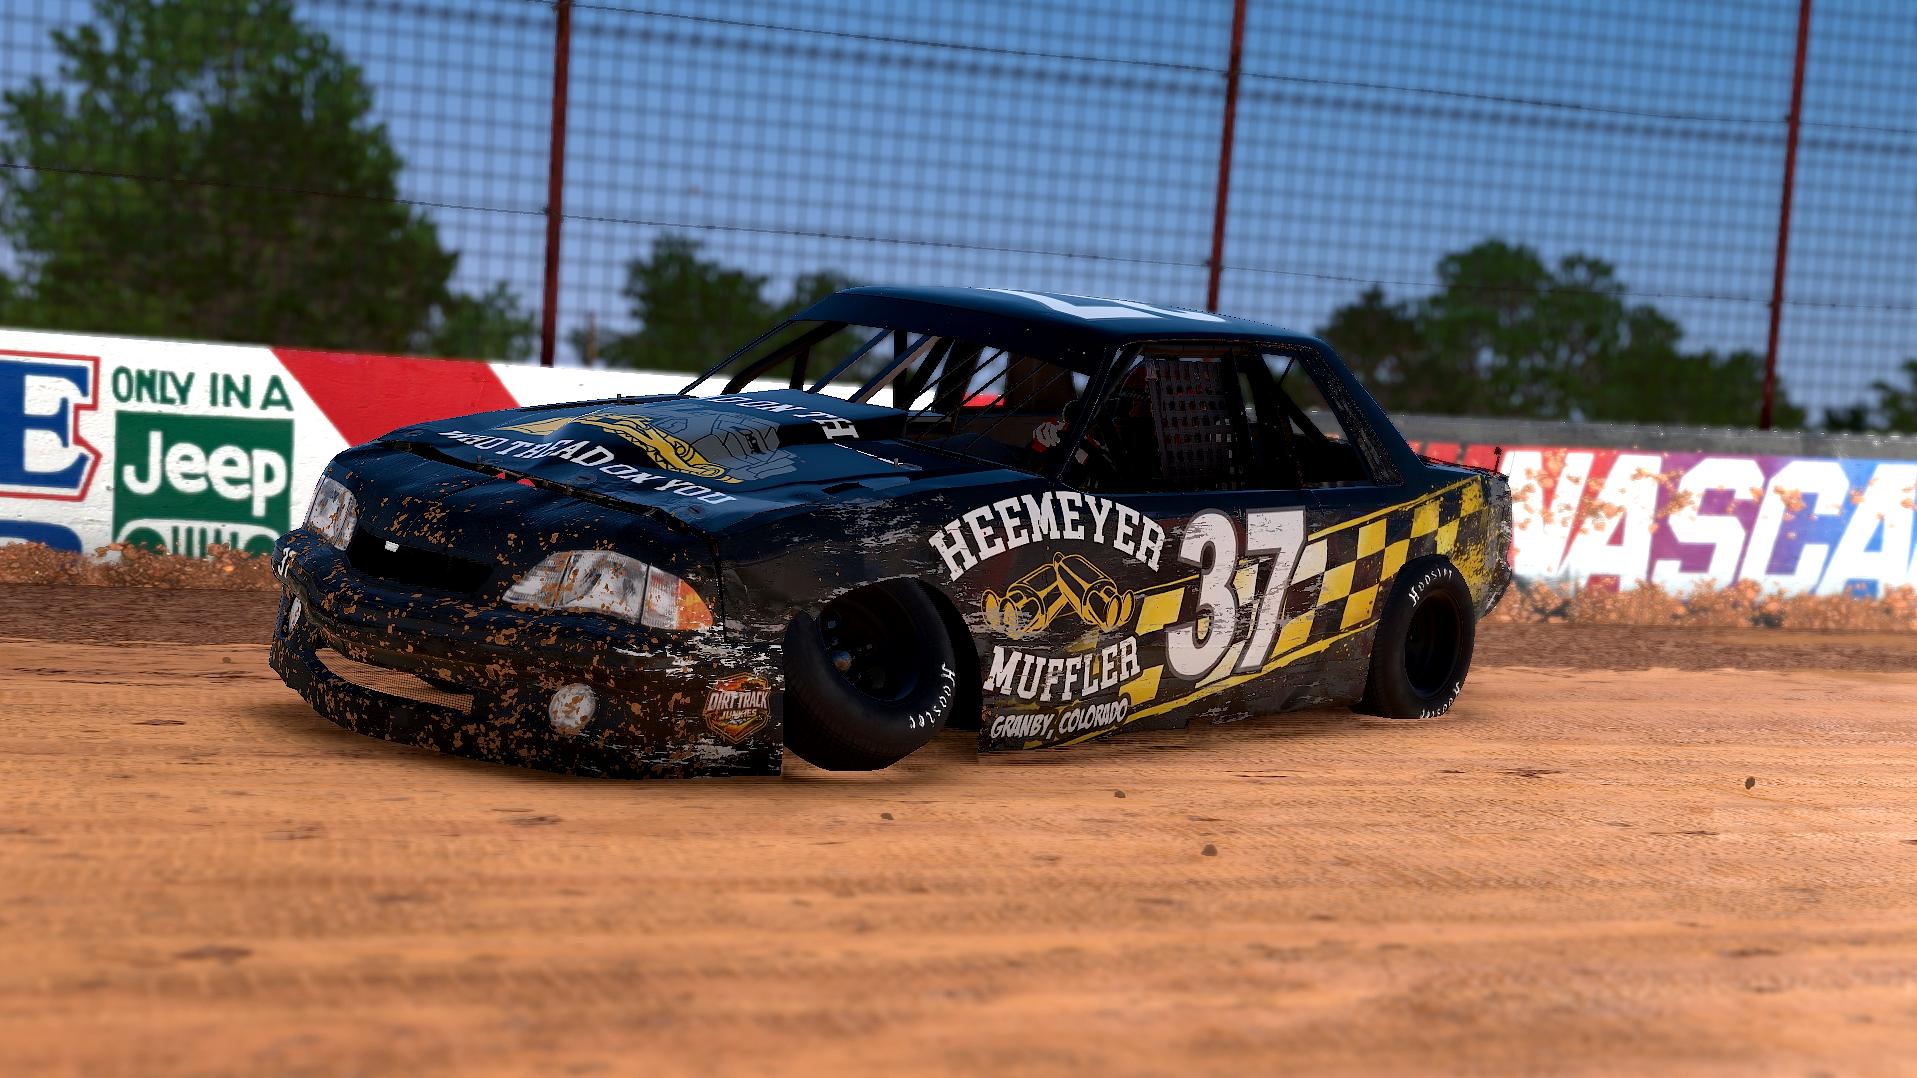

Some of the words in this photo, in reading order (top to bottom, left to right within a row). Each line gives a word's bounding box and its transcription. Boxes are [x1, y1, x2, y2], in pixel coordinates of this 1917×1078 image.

[112, 365, 196, 406] ONLY
[209, 371, 252, 409] IN
[260, 374, 294, 412] A
[122, 430, 288, 518] Jeep
[599, 463, 667, 484] ON
[653, 478, 737, 505] YOU
[927, 490, 1167, 583] HEEMEYER
[1500, 448, 1917, 599] NASCA
[1165, 505, 1307, 682] 37
[737, 690, 768, 710] TRACK
[982, 635, 1142, 703] MUFFLER
[990, 712, 1054, 740] GRANBY,
[1058, 698, 1129, 735] COLORADO
